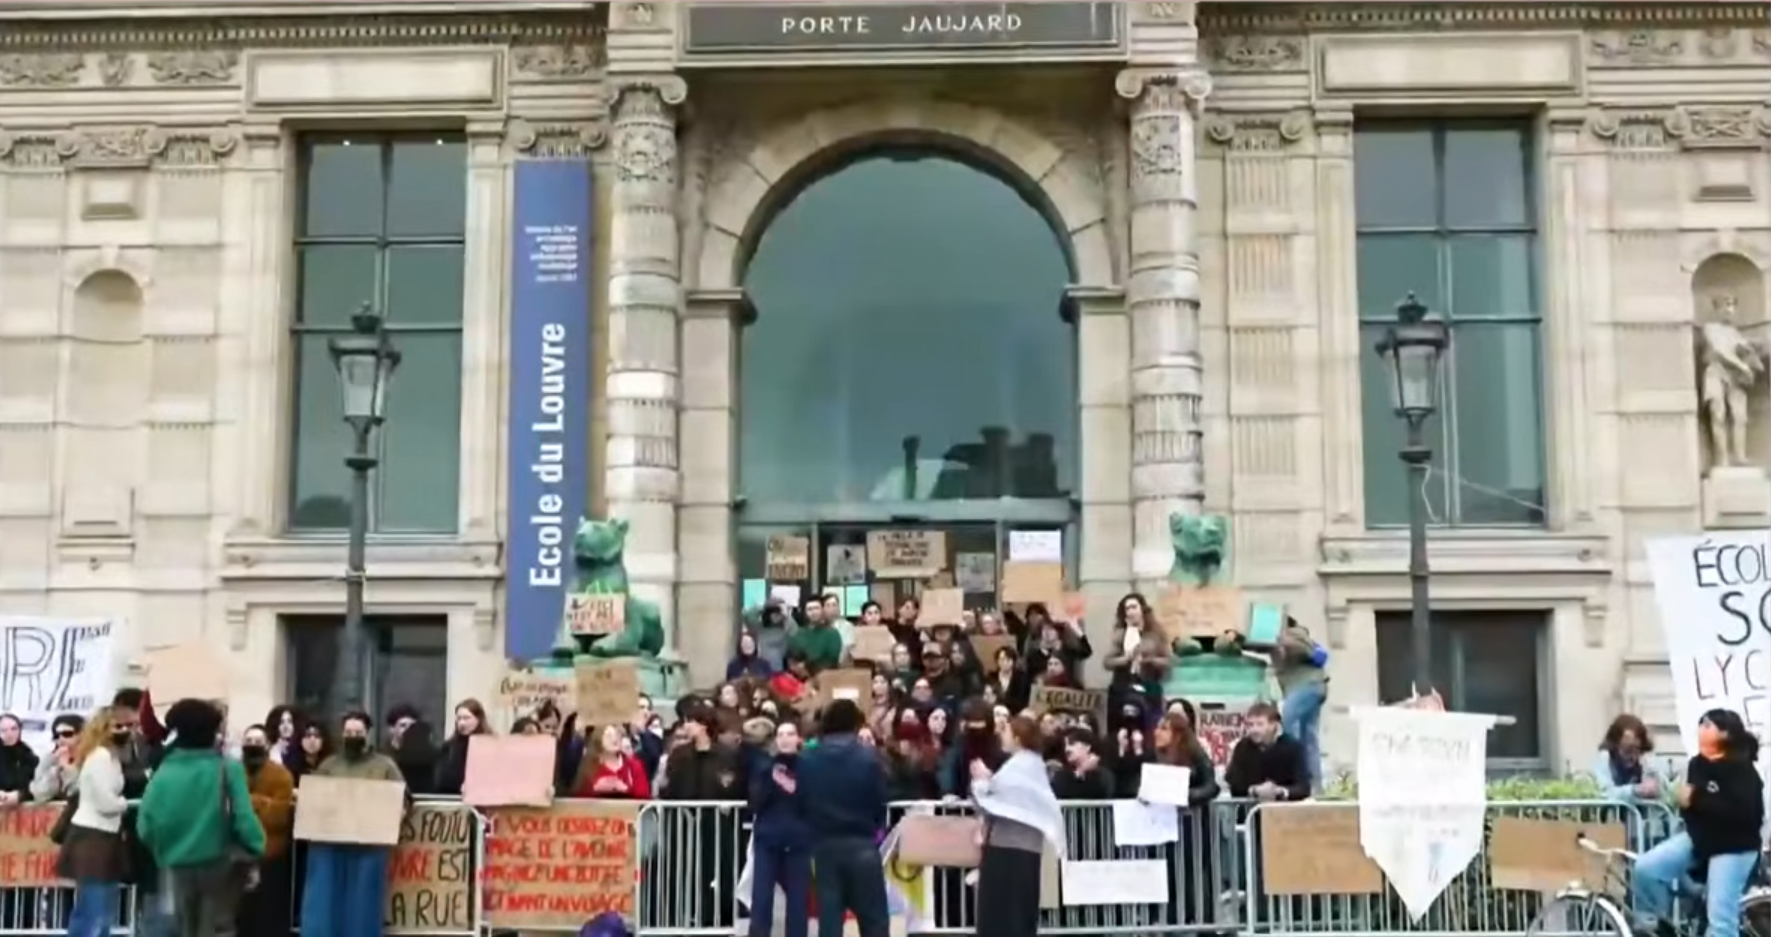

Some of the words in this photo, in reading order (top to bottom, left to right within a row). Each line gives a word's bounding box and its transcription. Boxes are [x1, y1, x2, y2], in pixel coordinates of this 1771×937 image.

[781, 16, 870, 33] PORTE
[902, 14, 1022, 33] JAUJARD
[532, 322, 566, 432] Louvre
[531, 441, 563, 482] du
[529, 515, 562, 588] Ecole
[438, 847, 470, 882] EST
[415, 888, 467, 928] RUE
